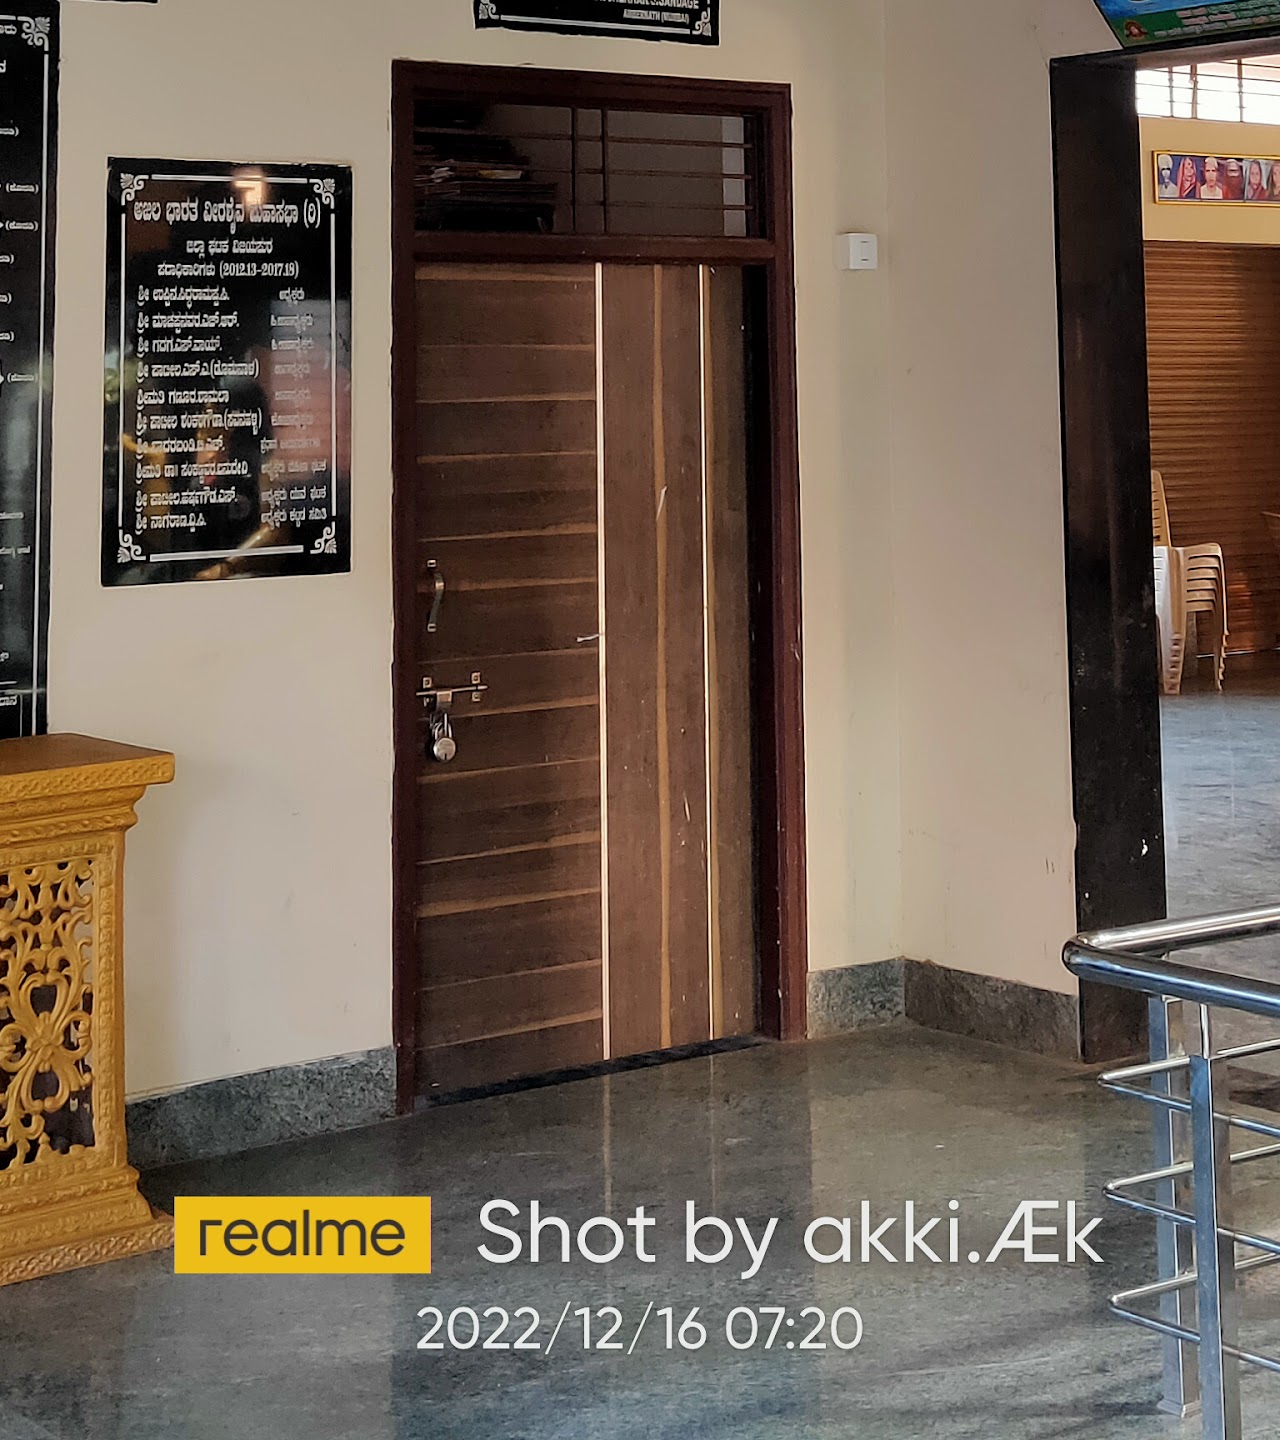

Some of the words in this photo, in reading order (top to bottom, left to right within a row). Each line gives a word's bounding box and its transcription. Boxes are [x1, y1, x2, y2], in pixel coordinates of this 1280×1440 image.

[166, 200, 198, 225] ಭಾರತ
[203, 197, 244, 234] ವೀರಶೈವ
[137, 285, 149, 306] ಶ್ರೀ
